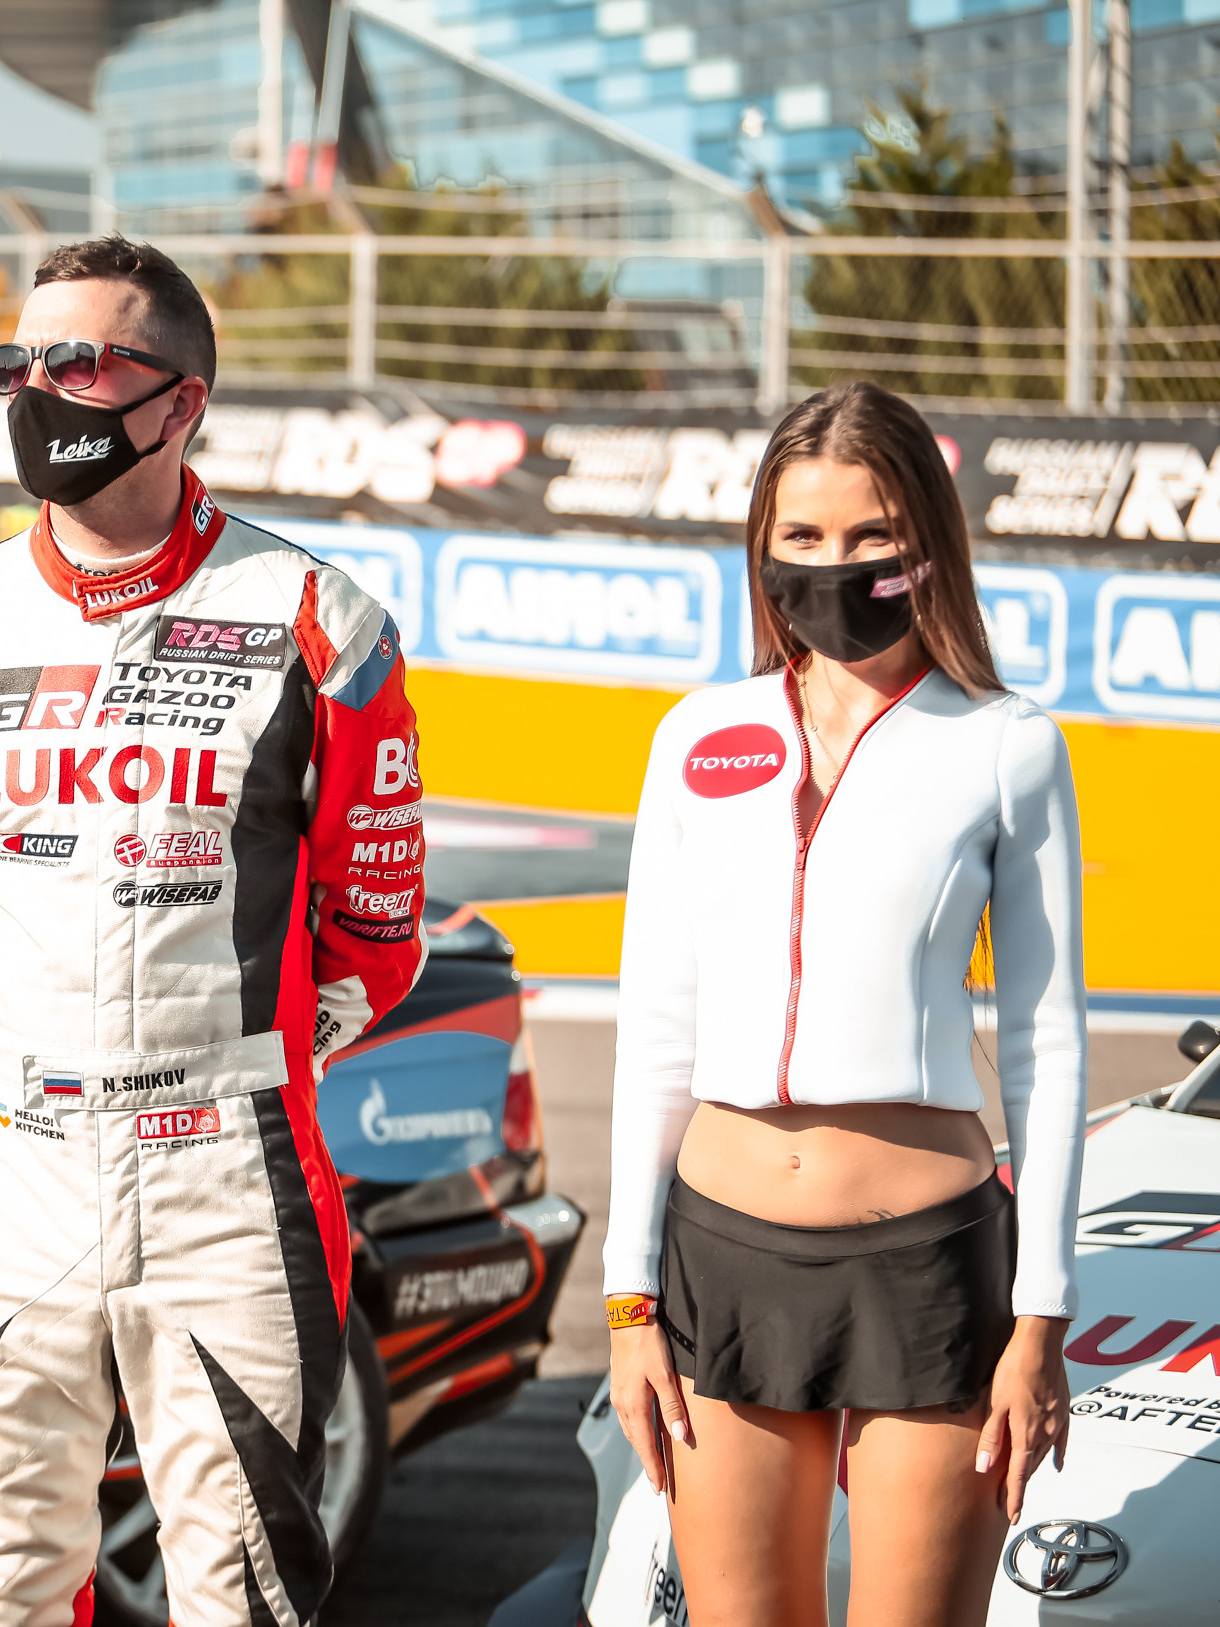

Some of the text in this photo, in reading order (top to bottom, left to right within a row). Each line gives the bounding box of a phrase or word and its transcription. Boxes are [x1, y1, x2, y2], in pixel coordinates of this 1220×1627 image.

[195, 494, 216, 531] GR
[84, 576, 160, 608] LUKOIL
[164, 622, 285, 651] RDS GP
[159, 647, 282, 665] RUSSIAN DRIFT SERIES
[114, 662, 253, 691] TOYOTA
[101, 685, 237, 710] GAZOO
[93, 706, 226, 736] Racing
[690, 753, 779, 771] TOYOTA
[20, 836, 74, 855] KING
[146, 831, 222, 859] FEAL
[351, 839, 409, 863] M1D
[348, 863, 421, 880] RACING
[141, 883, 223, 906] WISEFAB
[346, 885, 416, 914] freem
[338, 916, 414, 938] VDRIFTE.RU
[102, 1068, 186, 1093] N.SHIKOV
[15, 1109, 54, 1127] HELLO!
[138, 1114, 193, 1138] M1D
[15, 1120, 65, 1141] KITCHEN
[140, 1137, 218, 1151] RACING
[1086, 1384, 1209, 1409] Powered
[1069, 1400, 1220, 1434] @AFTE
